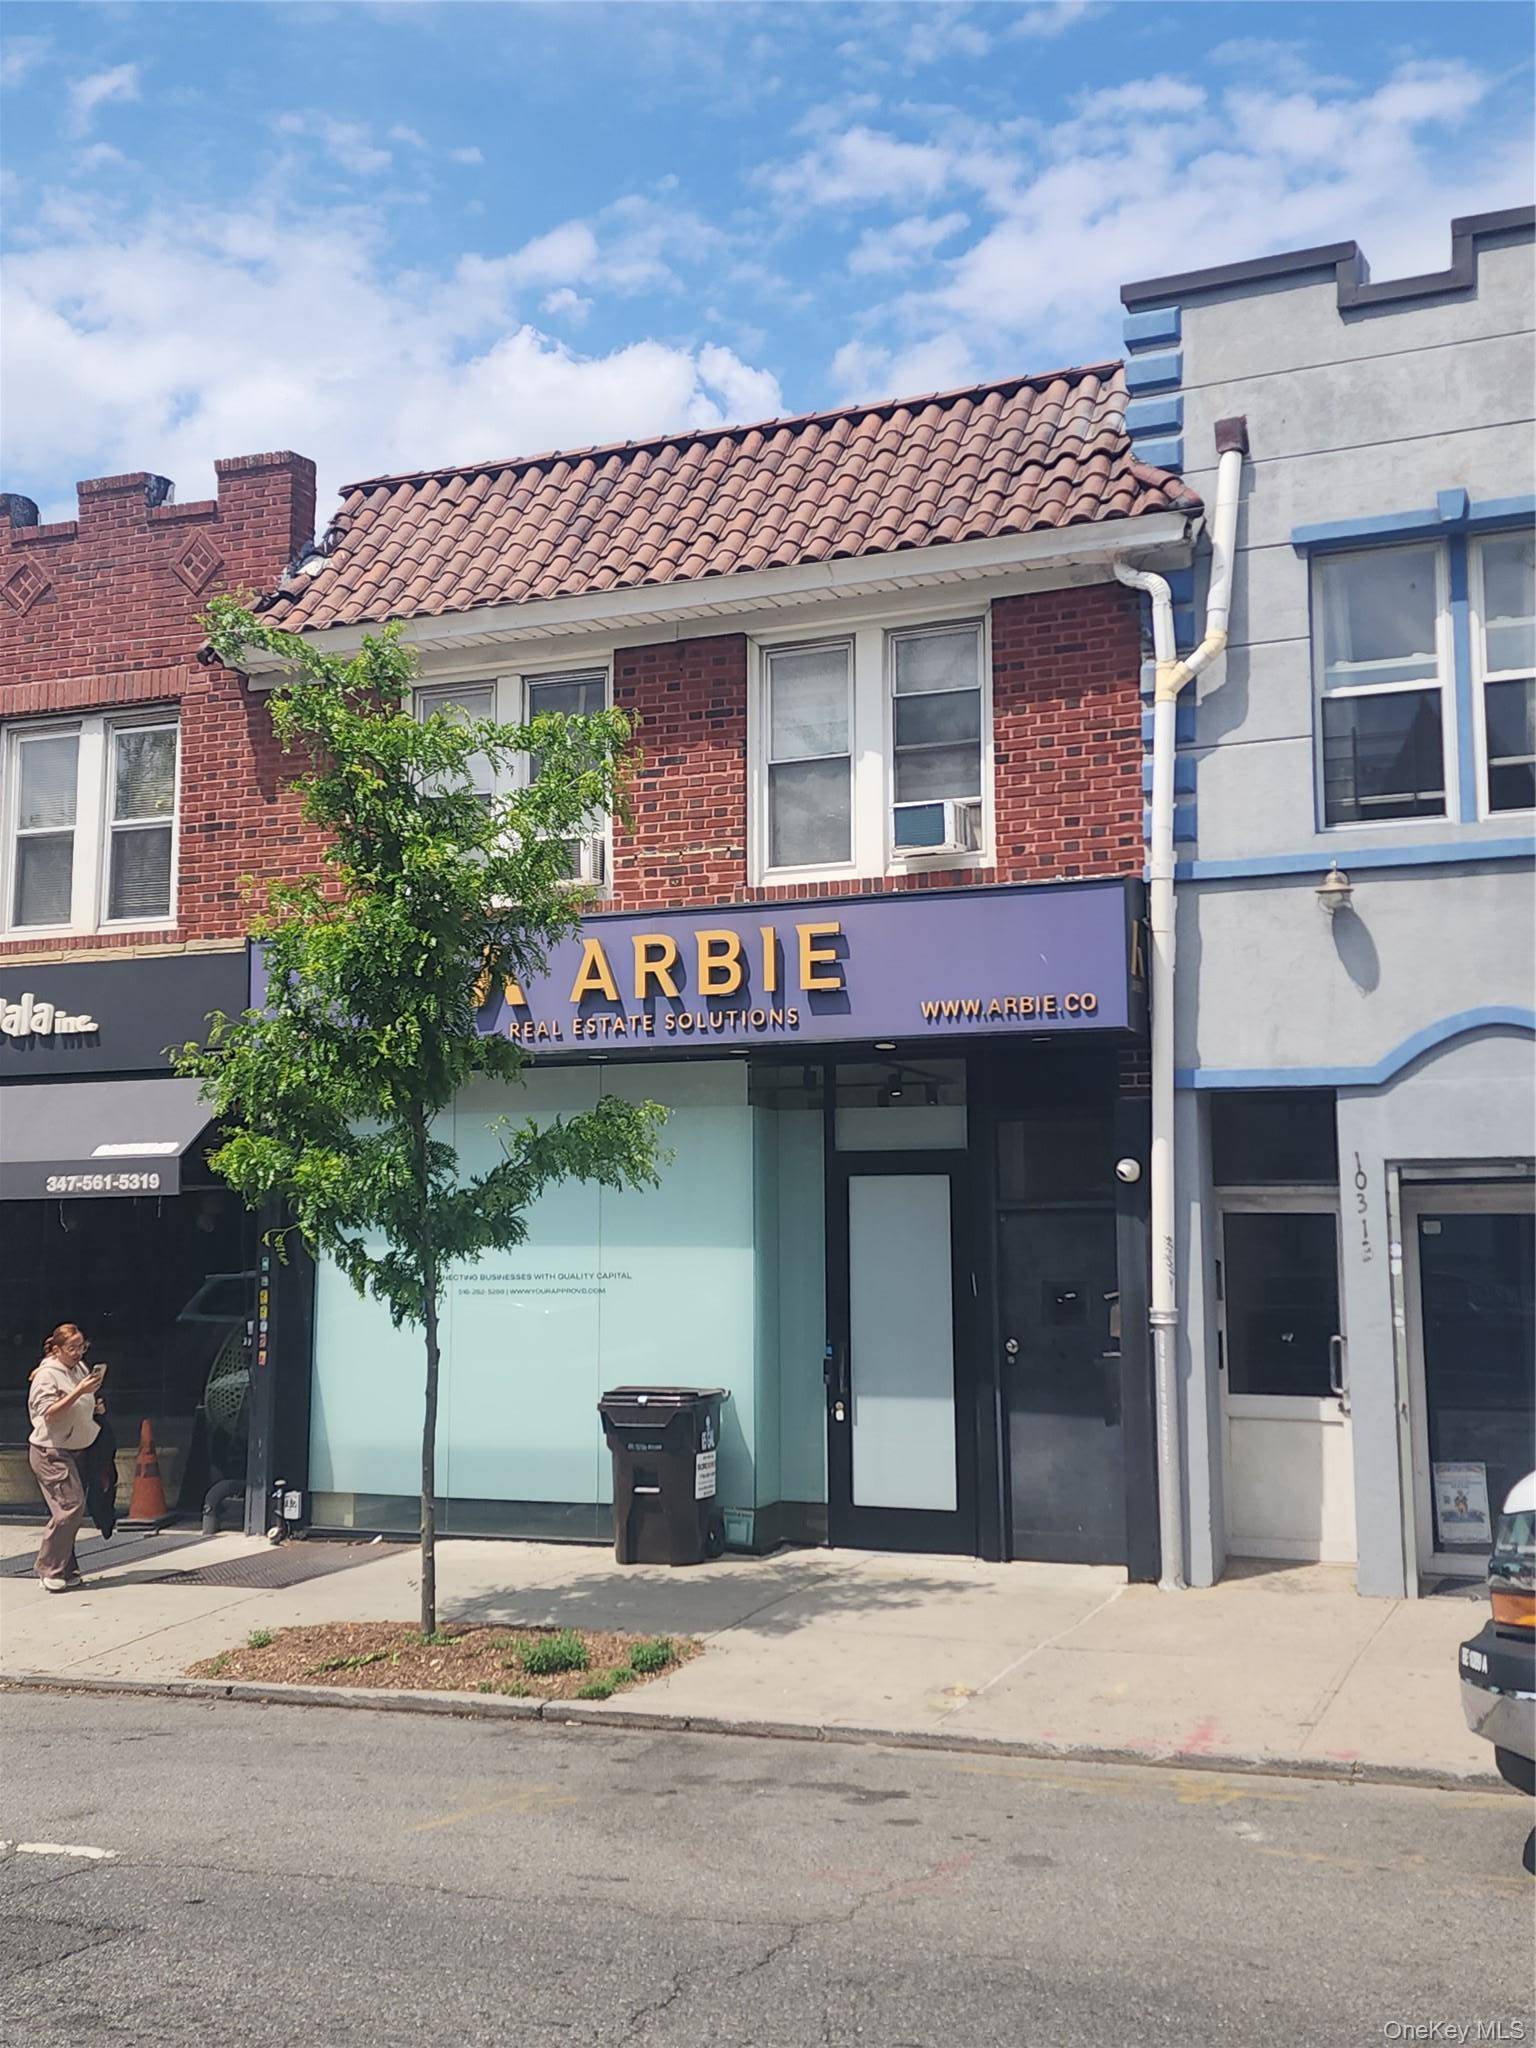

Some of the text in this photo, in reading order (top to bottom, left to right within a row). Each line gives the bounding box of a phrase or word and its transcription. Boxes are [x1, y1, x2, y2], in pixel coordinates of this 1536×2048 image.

[569, 920, 843, 1003] ARBIE
[920, 992, 1097, 1019] WWW.ARBIE.CO
[509, 1007, 798, 1038] REAL ESTATE SOLUTIONS
[46, 1172, 161, 1193] 347-561-5319
[479, 1273, 532, 1281] BUSINESSES
[533, 1273, 556, 1281] WITH
[557, 1272, 595, 1281] QUALITY
[596, 1271, 633, 1280] CAPITAL
